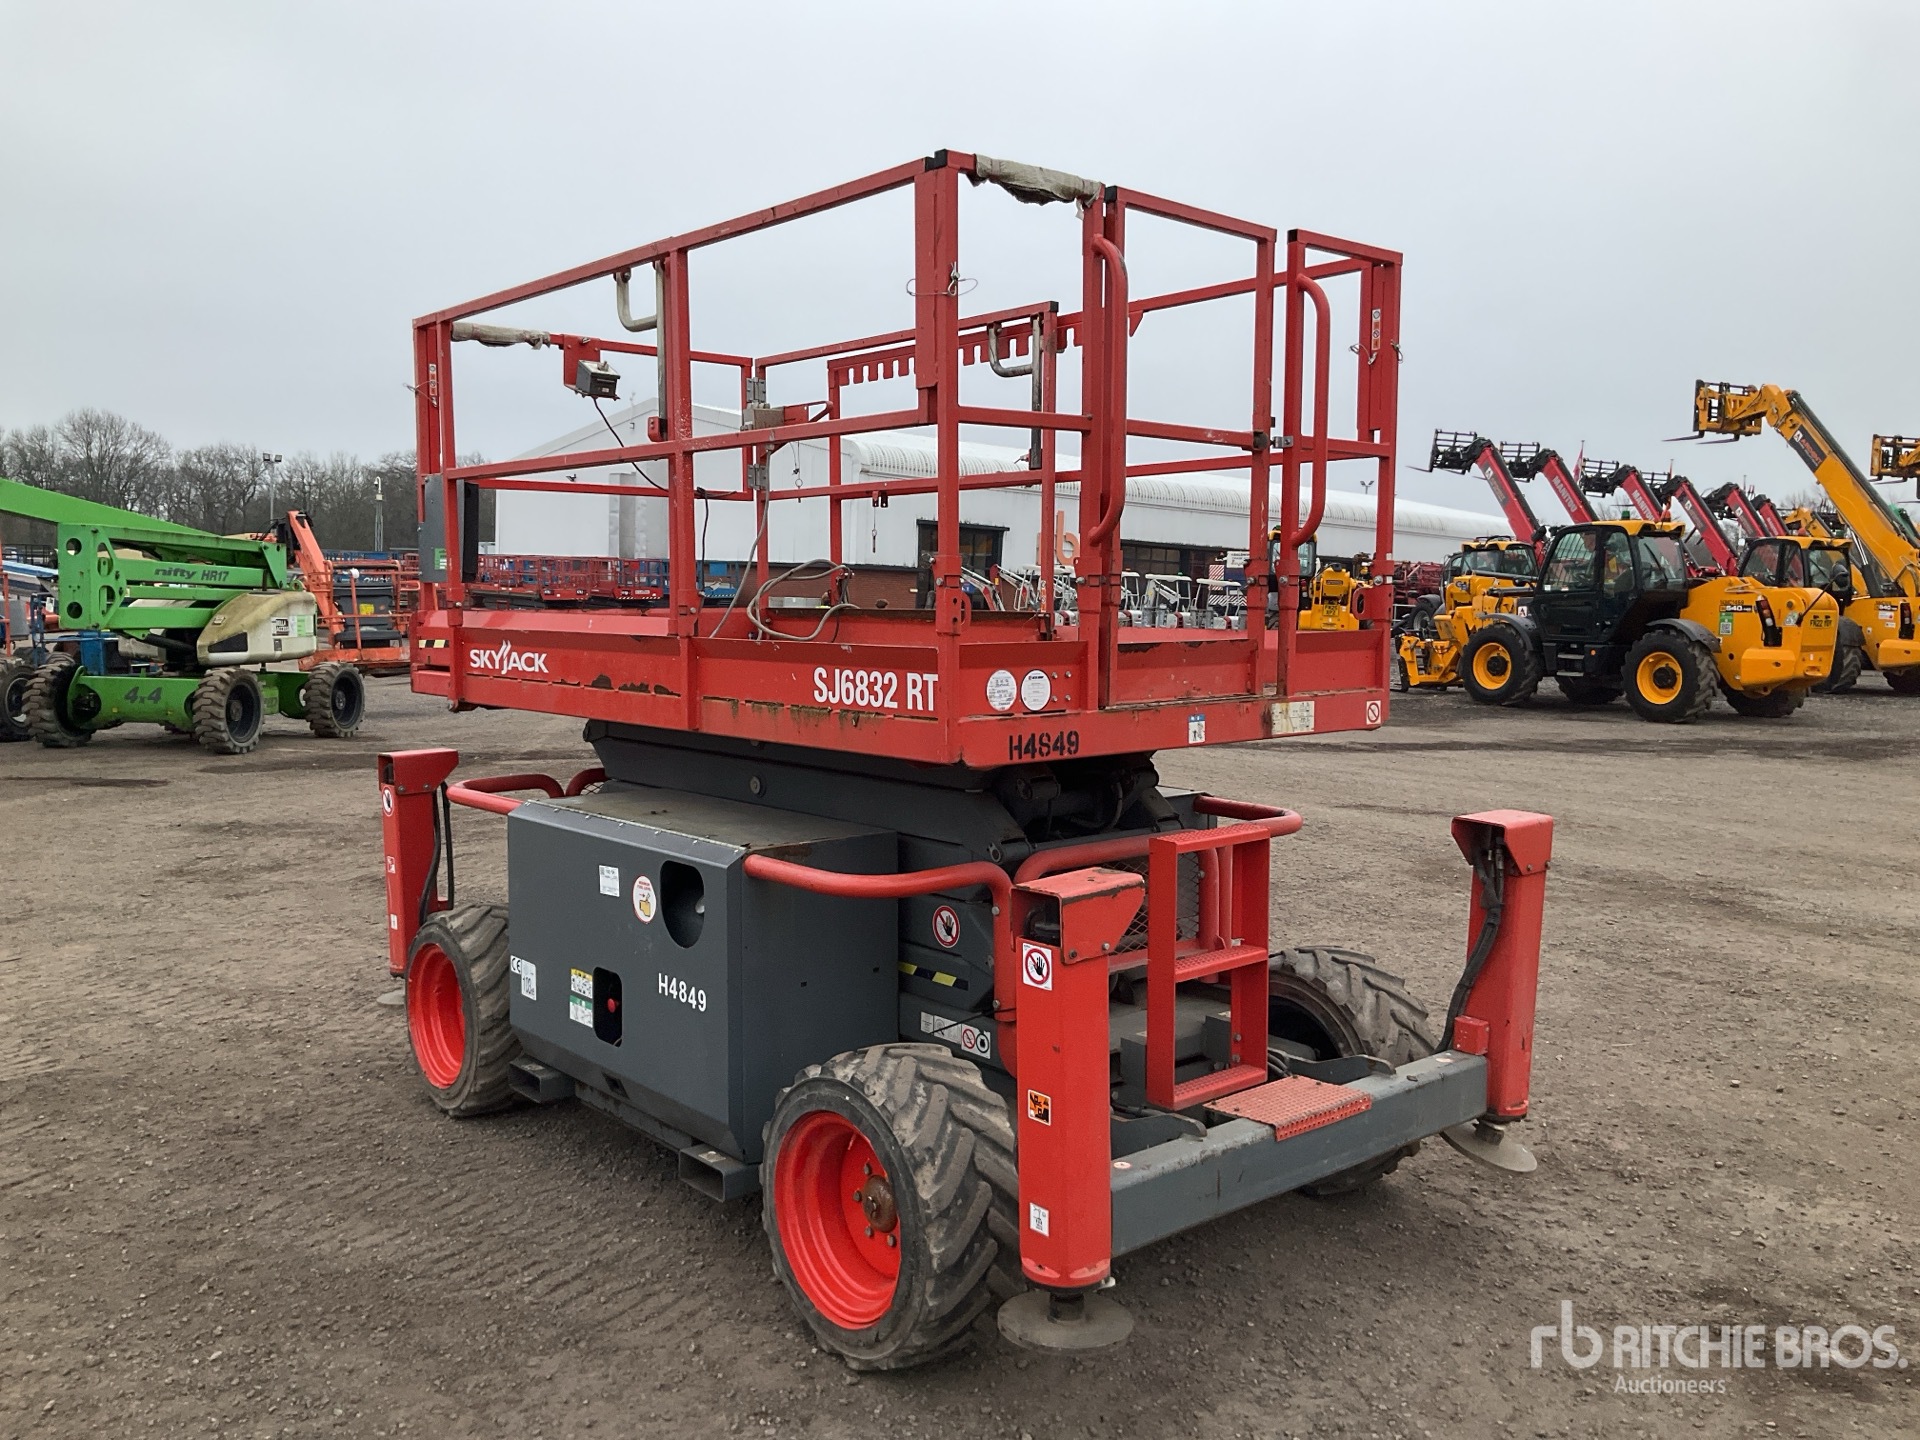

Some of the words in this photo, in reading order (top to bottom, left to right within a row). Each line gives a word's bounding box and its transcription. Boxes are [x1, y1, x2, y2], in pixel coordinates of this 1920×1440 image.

[1552, 475, 1578, 513] MANITOU
[154, 567, 197, 580] nifty
[201, 569, 229, 582] HR17
[469, 640, 549, 675] SKYJACK
[123, 686, 163, 704] 4x4
[813, 666, 898, 709] SJ6832
[906, 672, 939, 711] RT
[1009, 730, 1079, 760] H4849
[658, 972, 707, 1012] H4849
